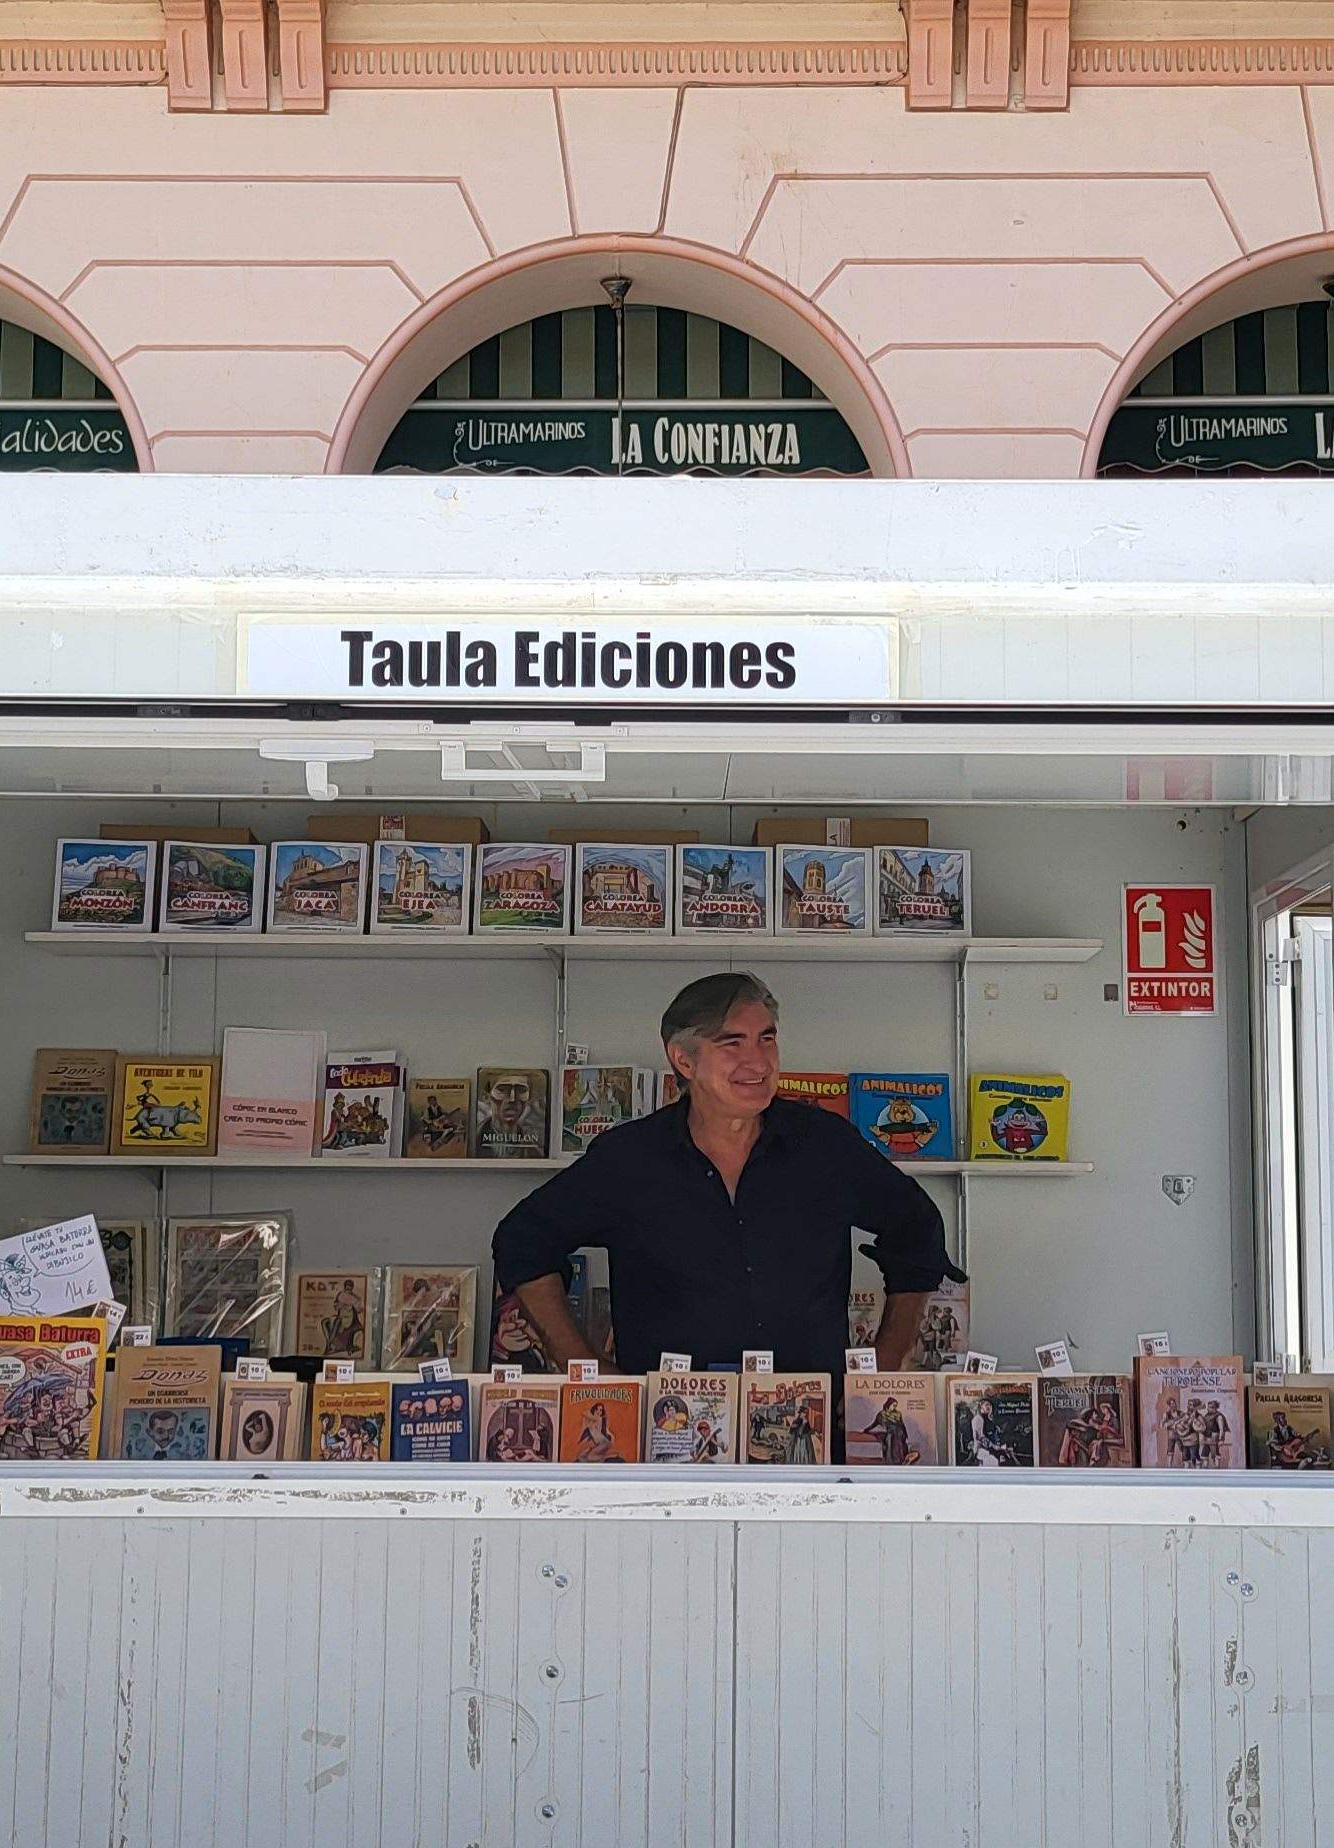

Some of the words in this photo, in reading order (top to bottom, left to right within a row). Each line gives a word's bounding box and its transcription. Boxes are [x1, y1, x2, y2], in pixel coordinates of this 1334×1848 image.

[341, 630, 497, 688] Taula
[514, 630, 797, 689] Ediciones
[296, 899, 336, 910] JACA
[402, 899, 437, 910] EJEA
[483, 900, 560, 912] ZARAGOZA
[585, 901, 662, 913] CALATAYUD
[687, 903, 760, 914] ANDORRA
[796, 902, 851, 915] TAUSTE
[896, 903, 947, 915] TERUEL
[1130, 981, 1211, 997] EXTINTOR
[861, 1079, 944, 1096] ANIMALICOS
[978, 1079, 1065, 1098] ANIMALICOS
[40, 1323, 100, 1344] Baturra
[65, 1347, 92, 1360] EXTRA
[1052, 1351, 1061, 1359] 10
[757, 1358, 766, 1366] 10
[860, 1356, 869, 1364] 10
[583, 1367, 592, 1375] 10
[980, 1363, 990, 1371] 10
[506, 1372, 516, 1380] 10
[660, 1377, 727, 1392] DOLORES
[856, 1380, 870, 1389] LA
[873, 1379, 925, 1389] DOLORES
[570, 1389, 633, 1404] FRIVOLIDADES
[400, 1423, 414, 1436] LA
[416, 1420, 463, 1435] CALVICIE
